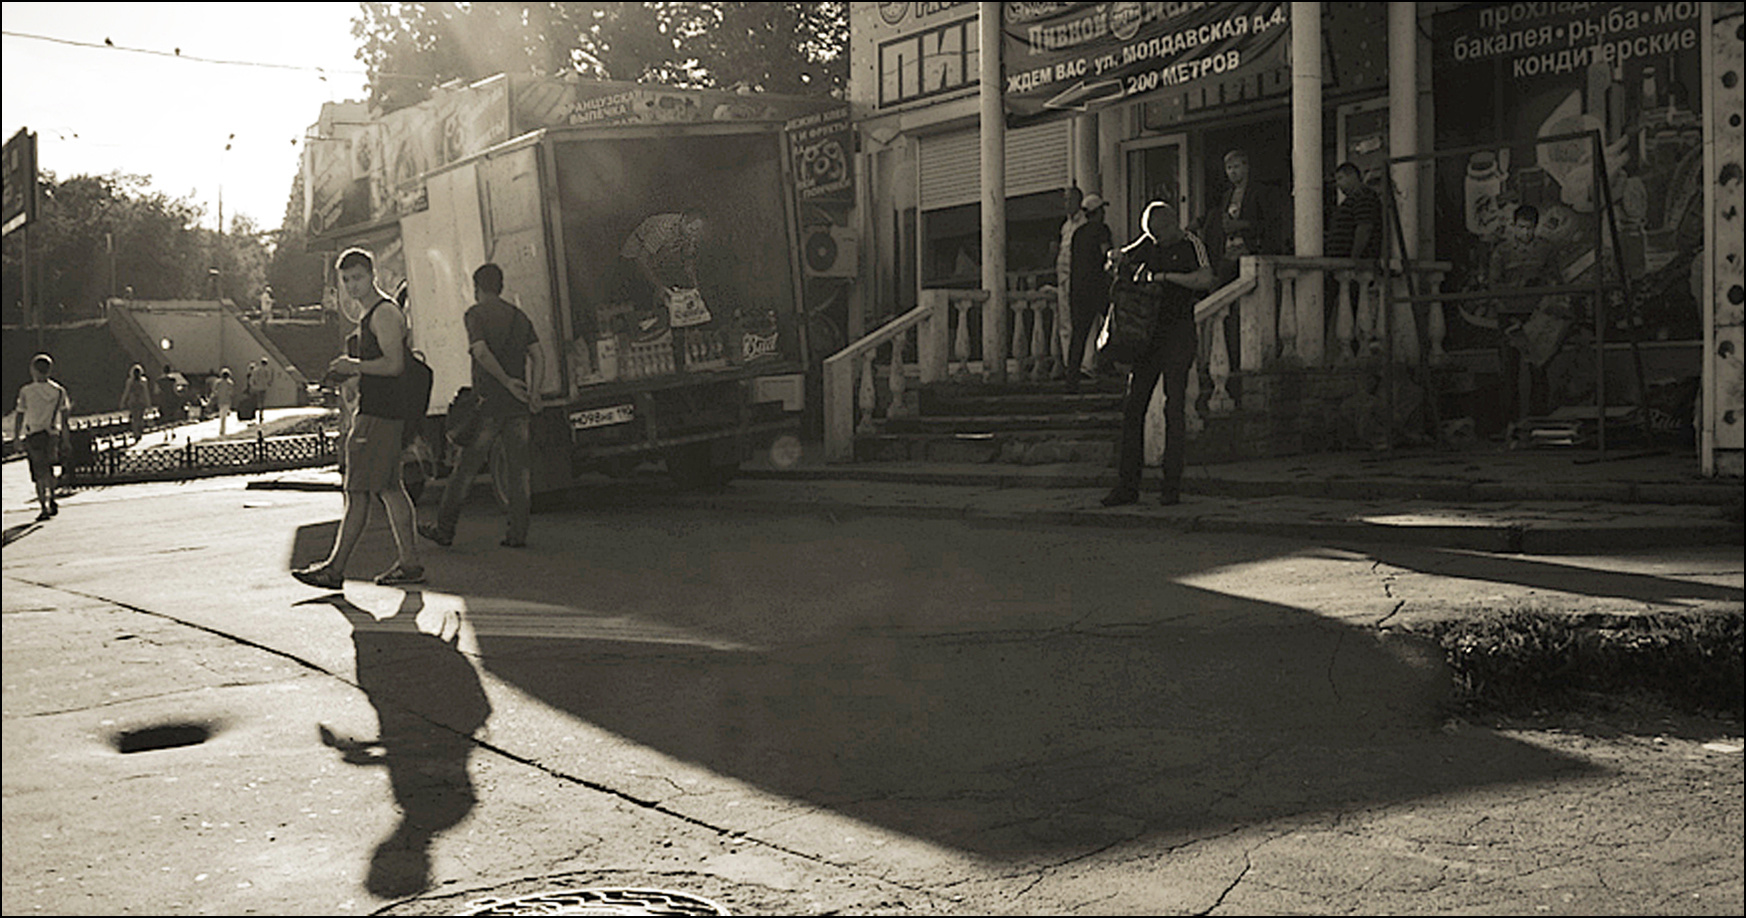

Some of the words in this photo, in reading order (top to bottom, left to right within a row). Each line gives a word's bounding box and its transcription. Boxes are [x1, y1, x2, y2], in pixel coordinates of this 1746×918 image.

[1007, 67, 1054, 93] ЖДЕМ
[1055, 58, 1087, 82] ВАС
[1093, 52, 1119, 76] ул.
[1122, 17, 1249, 65] МОЛДАВСКАЯ
[1453, 25, 1552, 61] бакалея
[1568, 7, 1639, 46] рыба
[1513, 28, 1697, 78] кондитерские
[1126, 72, 1159, 95] 200
[1162, 50, 1241, 86] МЕТРОВ
